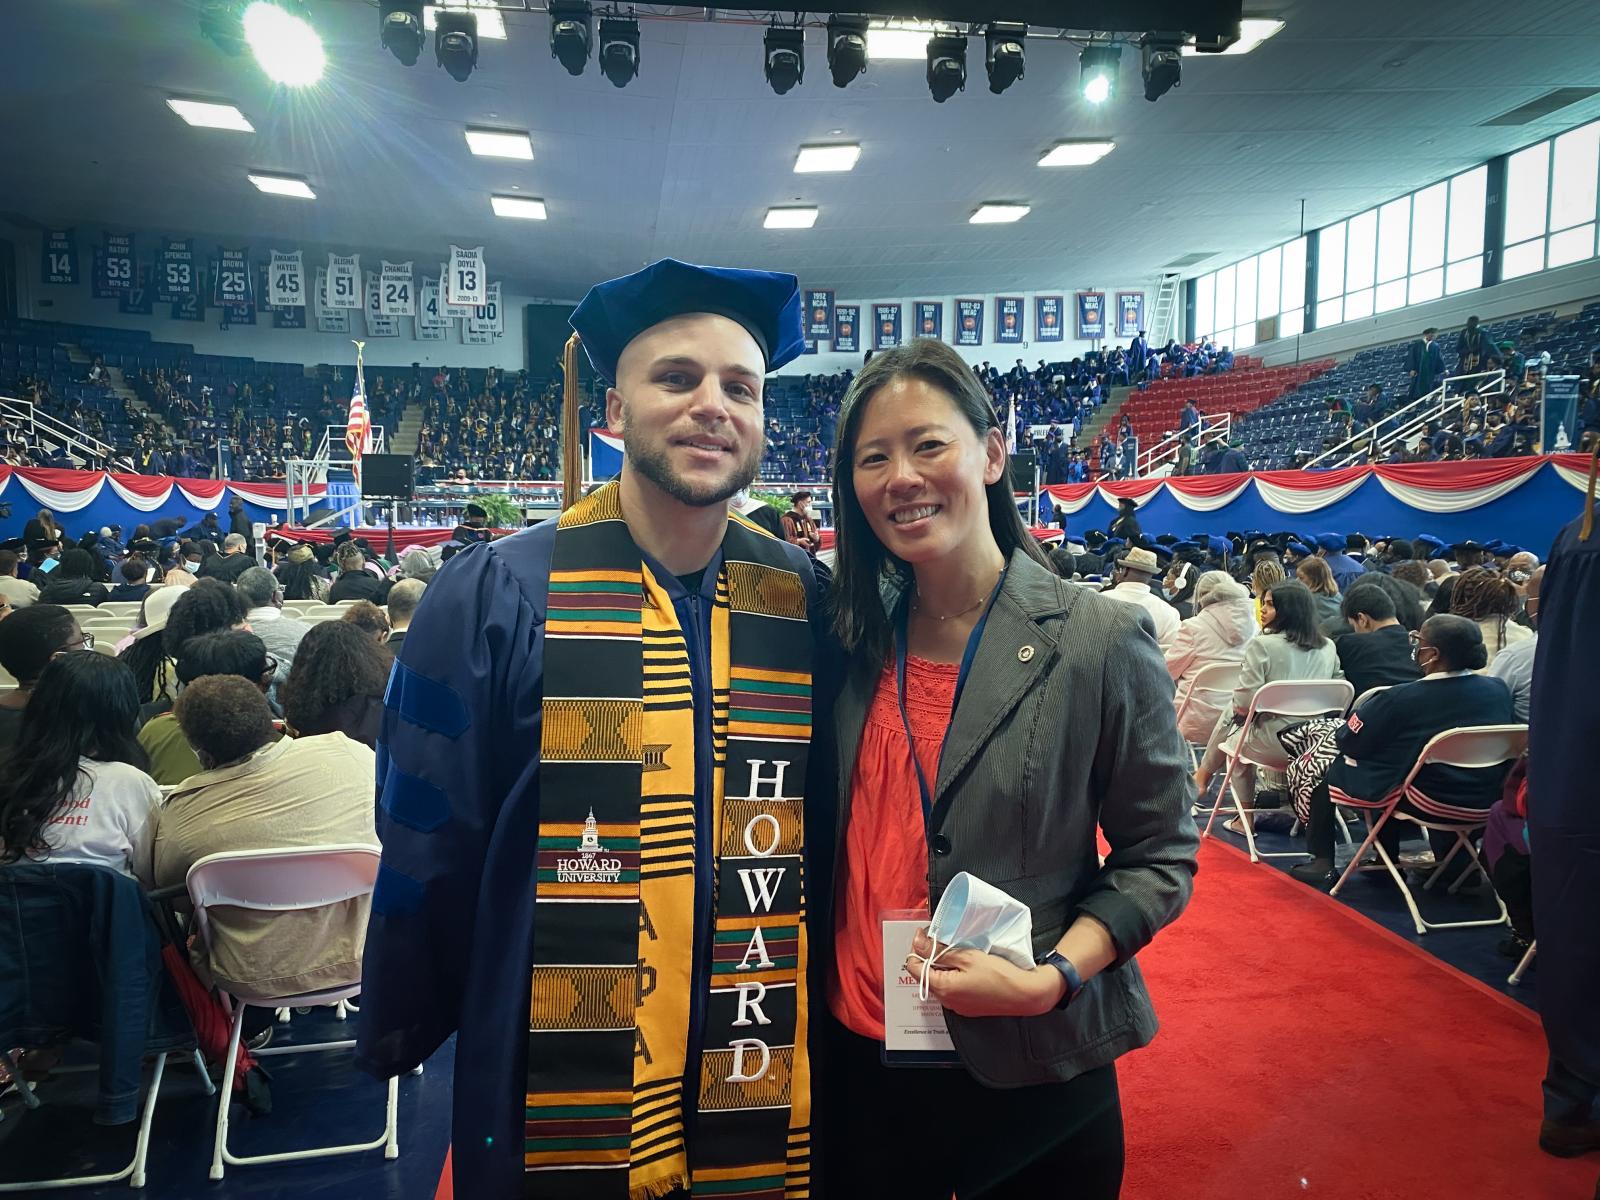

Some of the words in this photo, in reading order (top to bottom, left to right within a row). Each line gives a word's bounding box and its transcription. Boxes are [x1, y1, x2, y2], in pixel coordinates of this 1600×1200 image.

[1487, 250, 1494, 264] 7
[49, 254, 71, 274] 14
[107, 258, 131, 278] 53
[222, 260, 244, 268] BROWN
[338, 266, 351, 274] HILL
[384, 265, 410, 273] CHANELL
[457, 260, 477, 268] DOYLE
[167, 264, 191, 284] 53
[222, 272, 245, 292] 25
[276, 274, 300, 293] 45
[336, 277, 354, 296] 51
[458, 270, 477, 291] 13
[386, 284, 409, 303] 24
[813, 292, 827, 300] 1992
[812, 299, 828, 307] NCAA
[880, 313, 895, 321] MEAC
[963, 308, 978, 316] MEAC
[581, 852, 597, 860] 1867
[556, 858, 622, 872] HOWARD
[557, 872, 621, 883] UNIVERSITY
